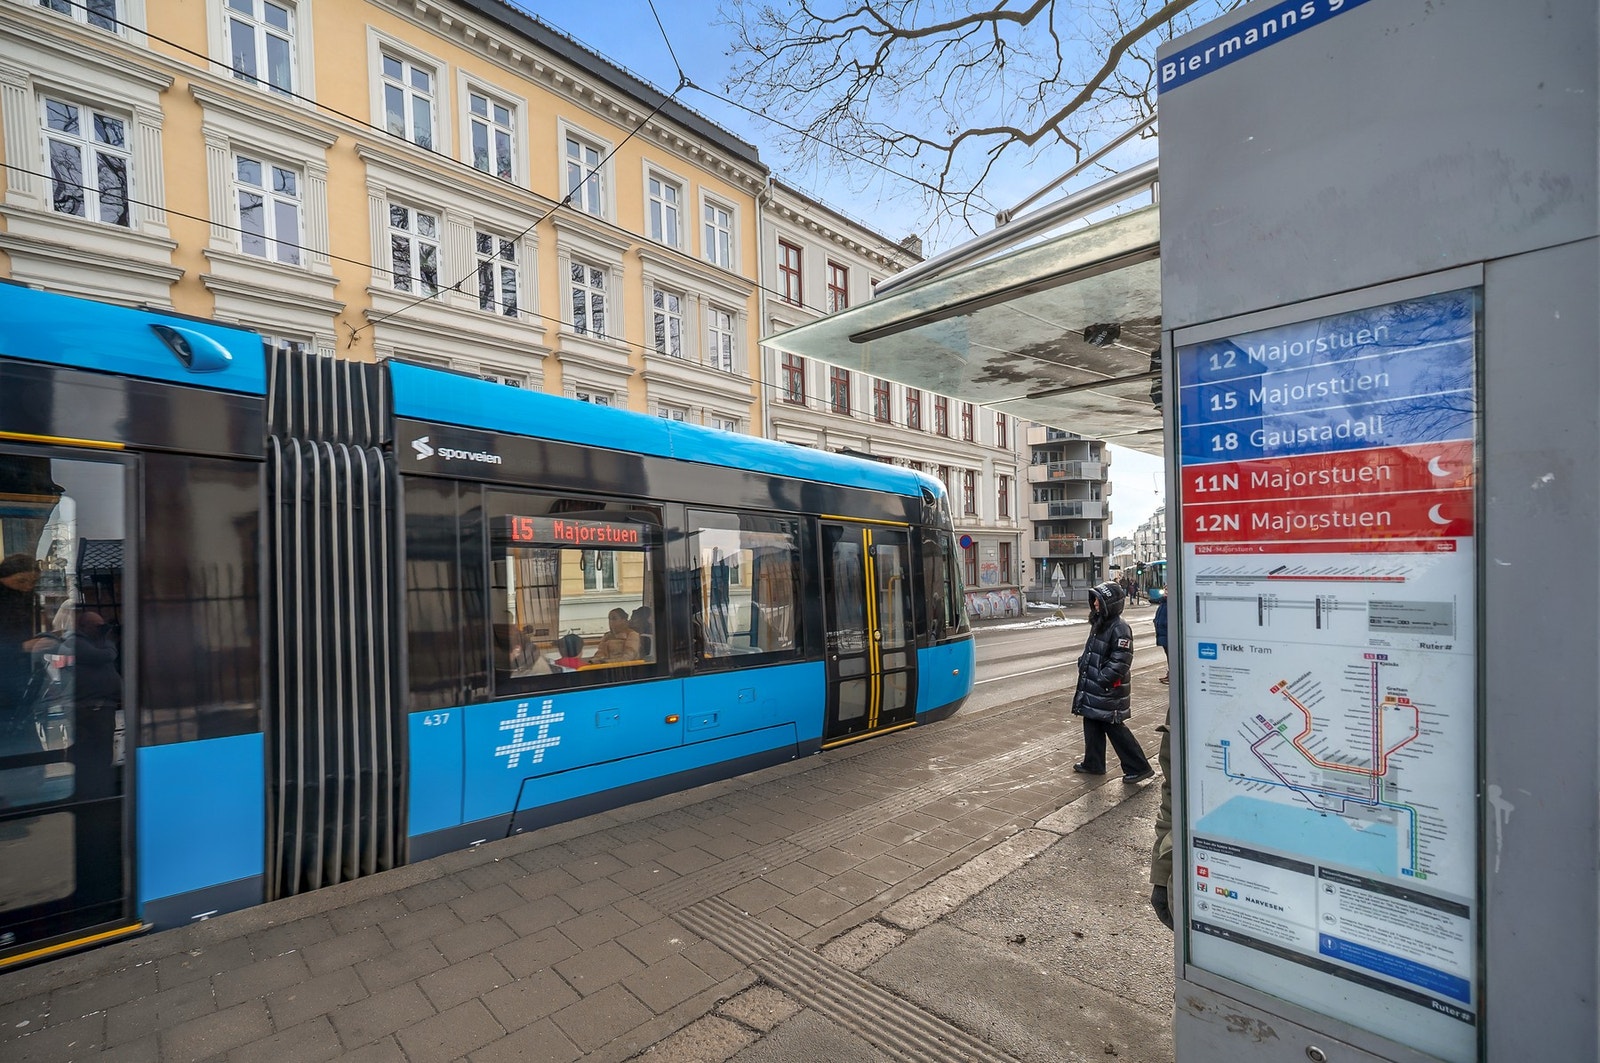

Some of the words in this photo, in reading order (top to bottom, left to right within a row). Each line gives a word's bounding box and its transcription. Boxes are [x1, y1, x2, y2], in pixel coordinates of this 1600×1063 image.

[1162, 1, 1315, 84] Biermanns
[1209, 350, 1237, 372] 12
[1248, 324, 1390, 365] Majorstuen
[1210, 392, 1238, 412] 15
[1249, 371, 1390, 408] Majorstuen
[1211, 433, 1239, 452] 18
[438, 446, 501, 465] sporveien
[1194, 473, 1239, 493] 11N
[1251, 463, 1391, 492] Majorstuen
[511, 517, 534, 541] 15
[554, 520, 638, 545] Majorstuen
[1195, 513, 1240, 532] 12N
[1252, 510, 1392, 533] Majorstuen
[1221, 643, 1244, 653] Trikk
[1249, 644, 1273, 655] Tram
[423, 713, 450, 727] 437
[1245, 896, 1285, 912] NARVESEN
